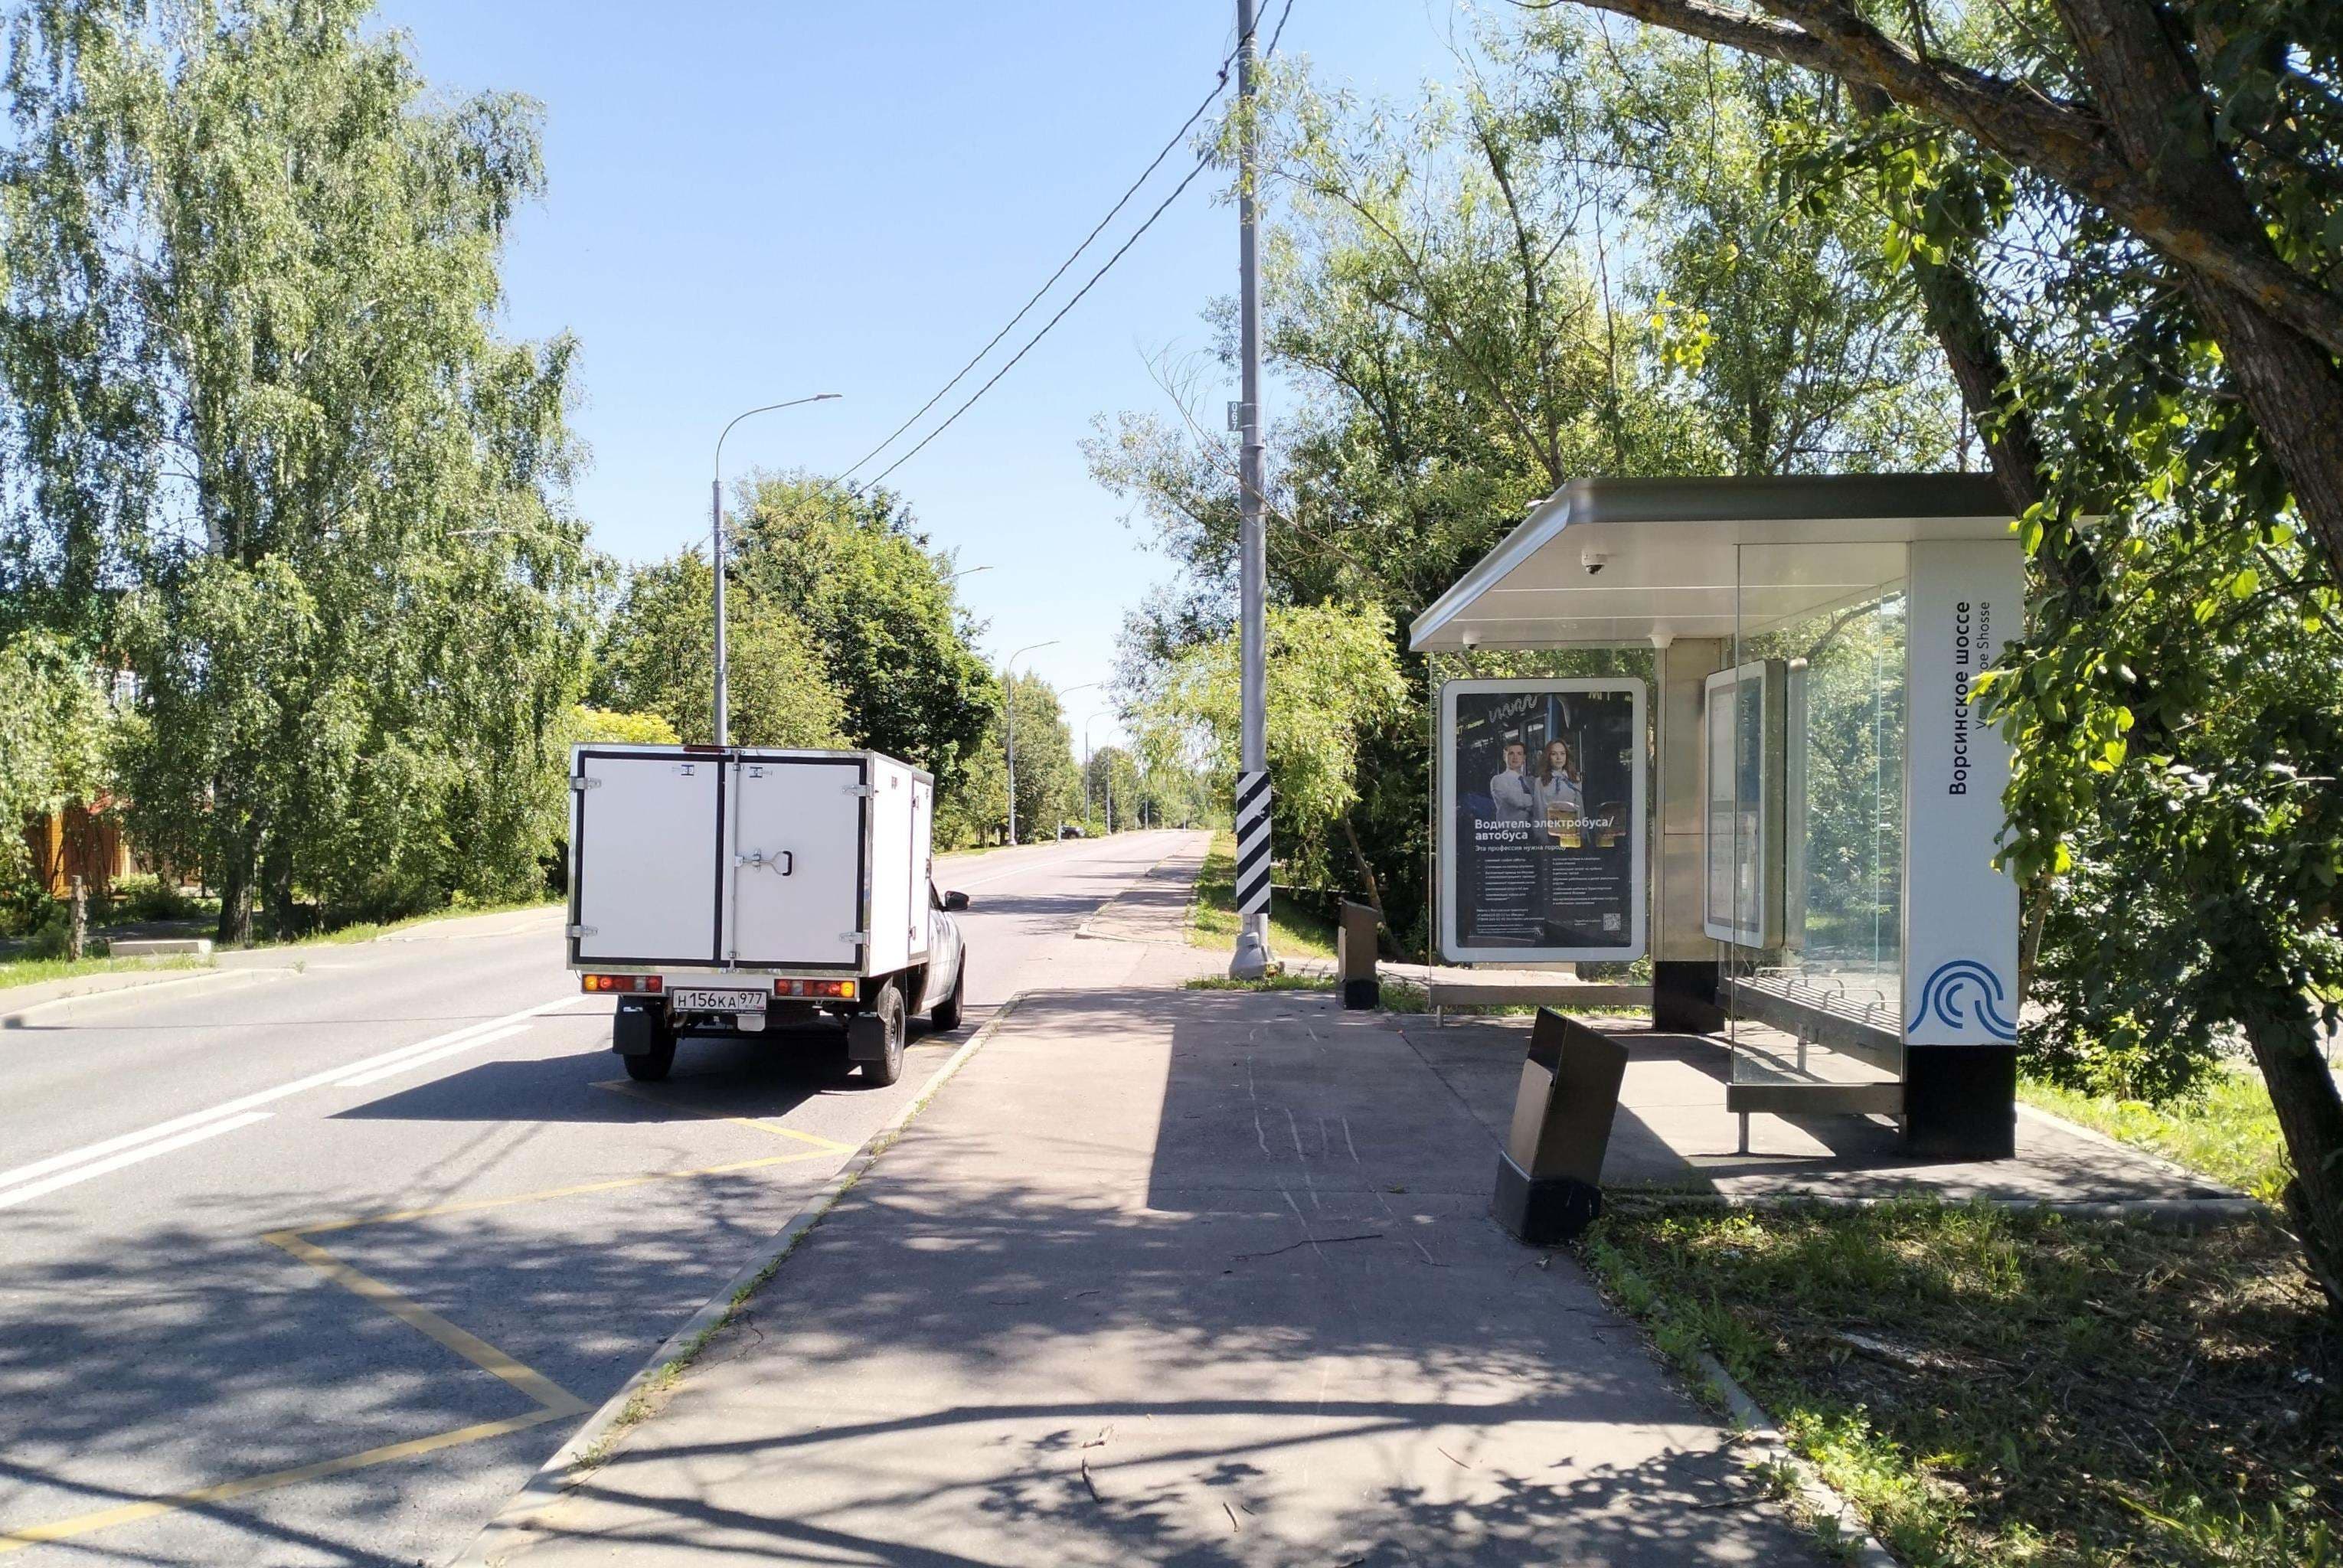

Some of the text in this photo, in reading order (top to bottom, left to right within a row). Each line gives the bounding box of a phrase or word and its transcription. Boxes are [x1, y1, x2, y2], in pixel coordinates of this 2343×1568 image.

[1977, 601, 1990, 648] Shosse
[1949, 602, 1971, 795] Ворсинское шоссе
[1475, 816, 1614, 830] Водитель электробуса/
[1475, 830, 1528, 841] автобуса
[740, 993, 763, 1004] 977
